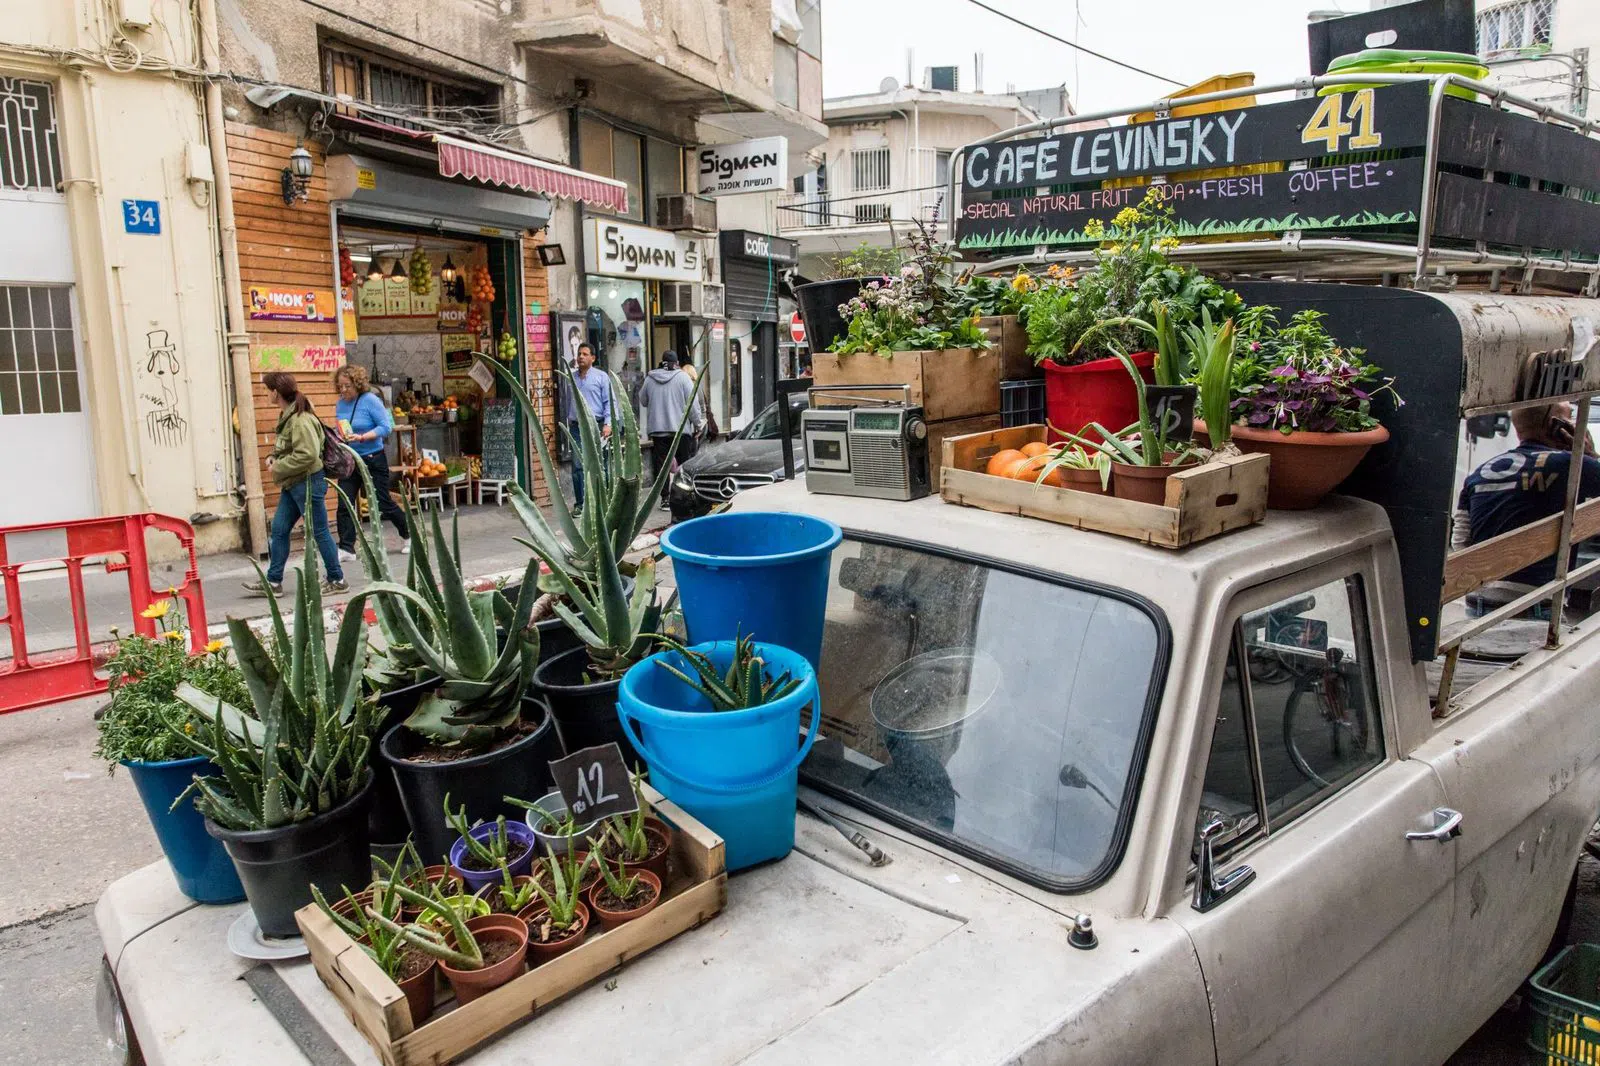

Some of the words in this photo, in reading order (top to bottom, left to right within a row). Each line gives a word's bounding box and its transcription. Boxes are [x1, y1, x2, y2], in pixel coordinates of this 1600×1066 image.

[1070, 112, 1248, 177] LEVINSKY
[1302, 91, 1382, 152] 41
[717, 180, 741, 191] אופנה
[743, 177, 773, 188] תעשיות
[966, 202, 1015, 220] SPECIAL
[1023, 193, 1085, 215] NATURAL
[1091, 188, 1133, 209] FRUIT
[1202, 175, 1264, 200] FRESH
[1289, 162, 1380, 193] COFFEE
[128, 205, 156, 227] 34
[745, 236, 769, 257] cofix
[577, 761, 620, 807] 12
